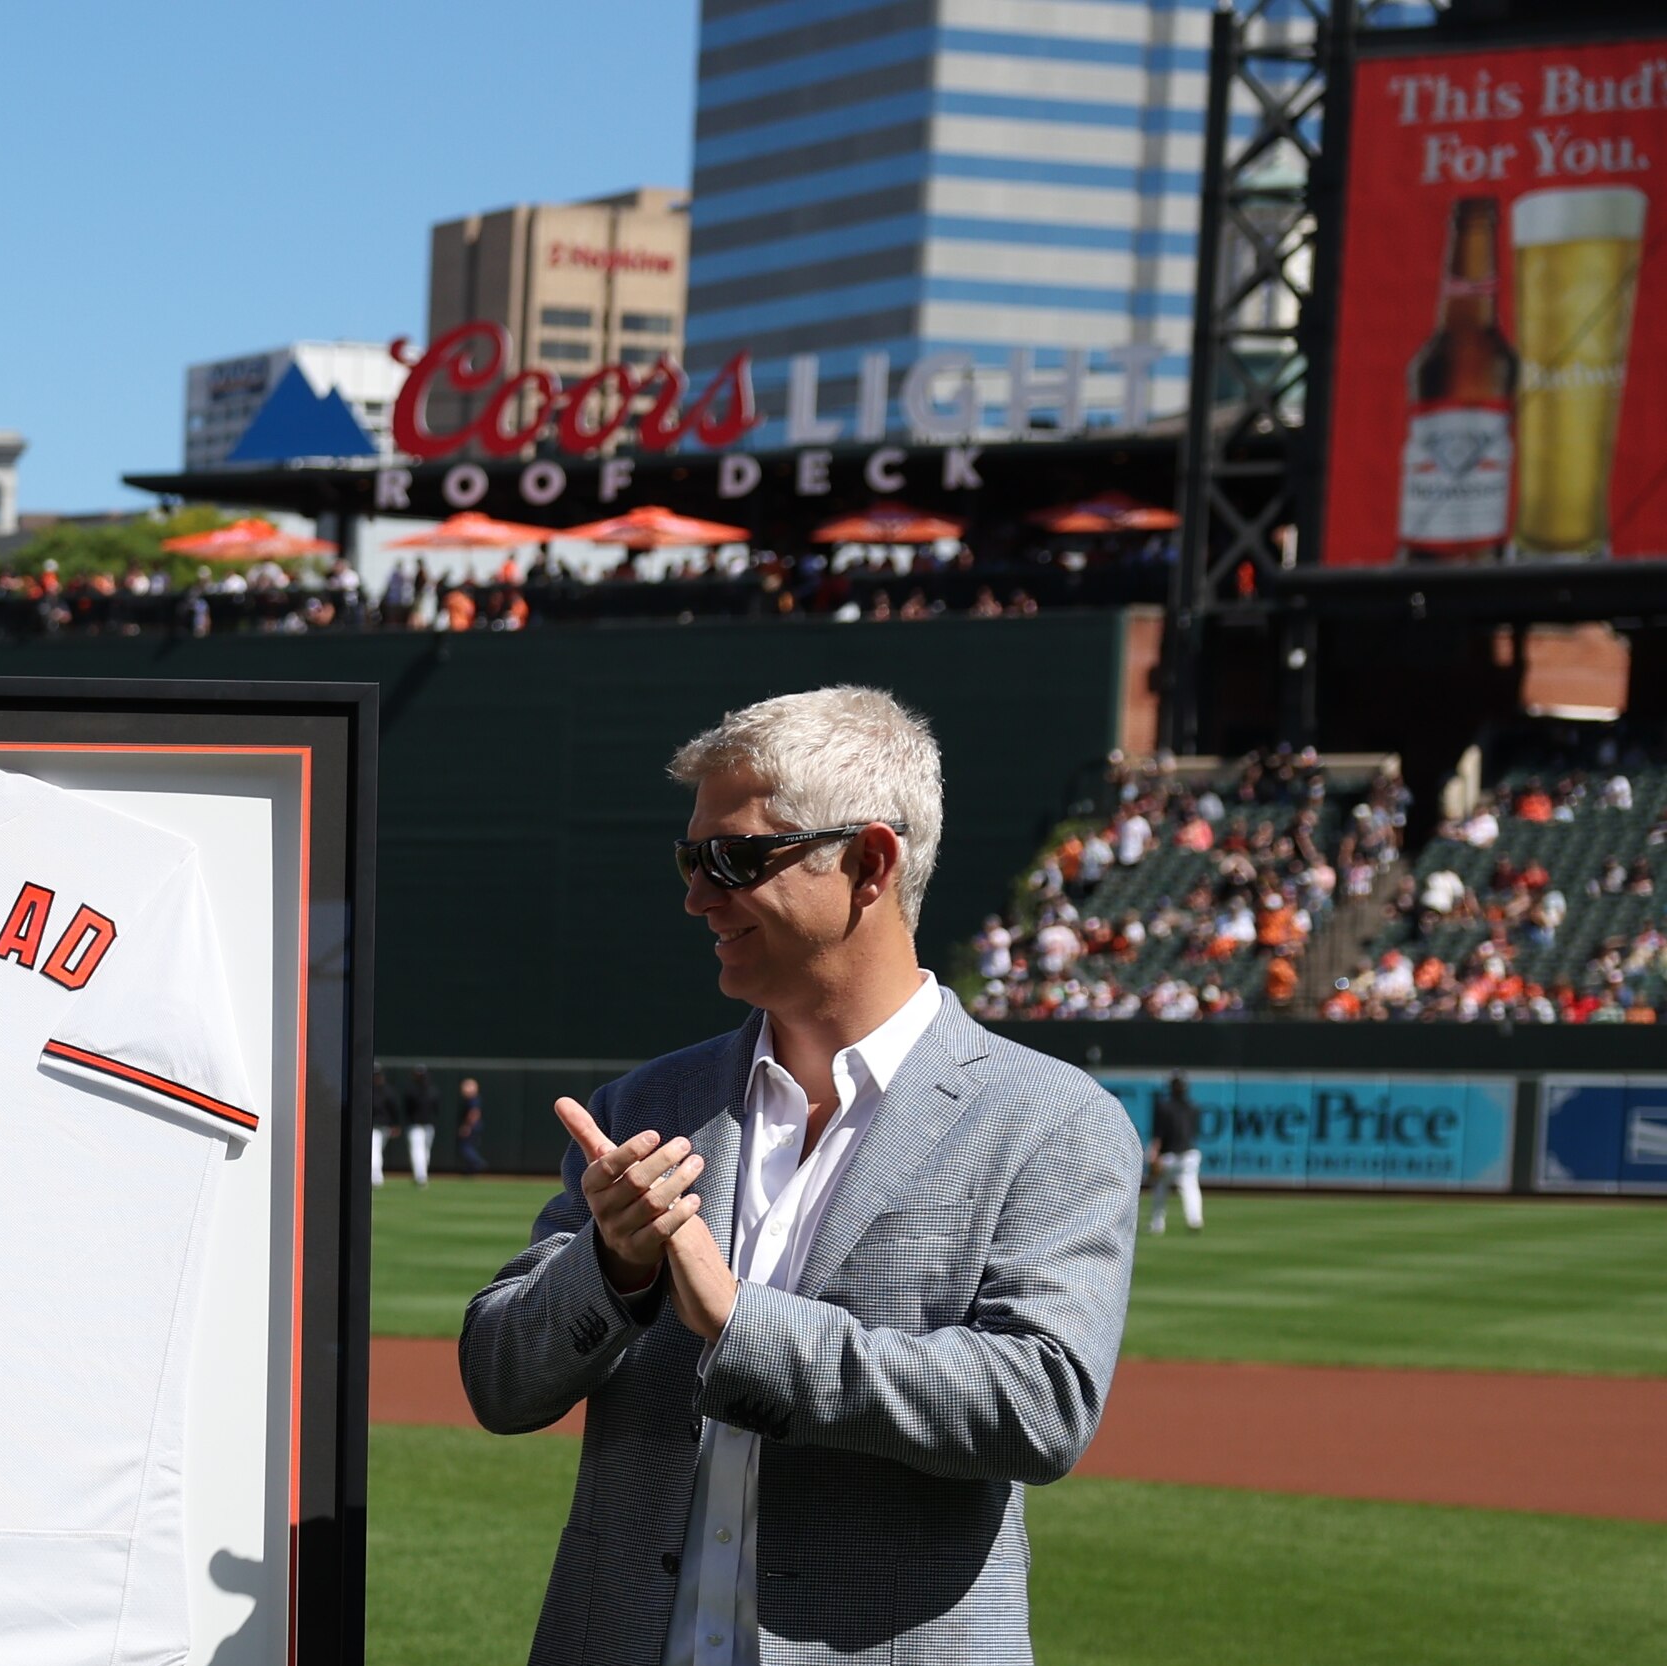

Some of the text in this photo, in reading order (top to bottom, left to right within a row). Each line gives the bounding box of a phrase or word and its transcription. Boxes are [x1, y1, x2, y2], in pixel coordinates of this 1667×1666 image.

[1388, 69, 1523, 125] This
[1422, 126, 1650, 184] For You.
[389, 320, 1165, 459] Coors LIGHT
[374, 447, 983, 509] ROOF DECK
